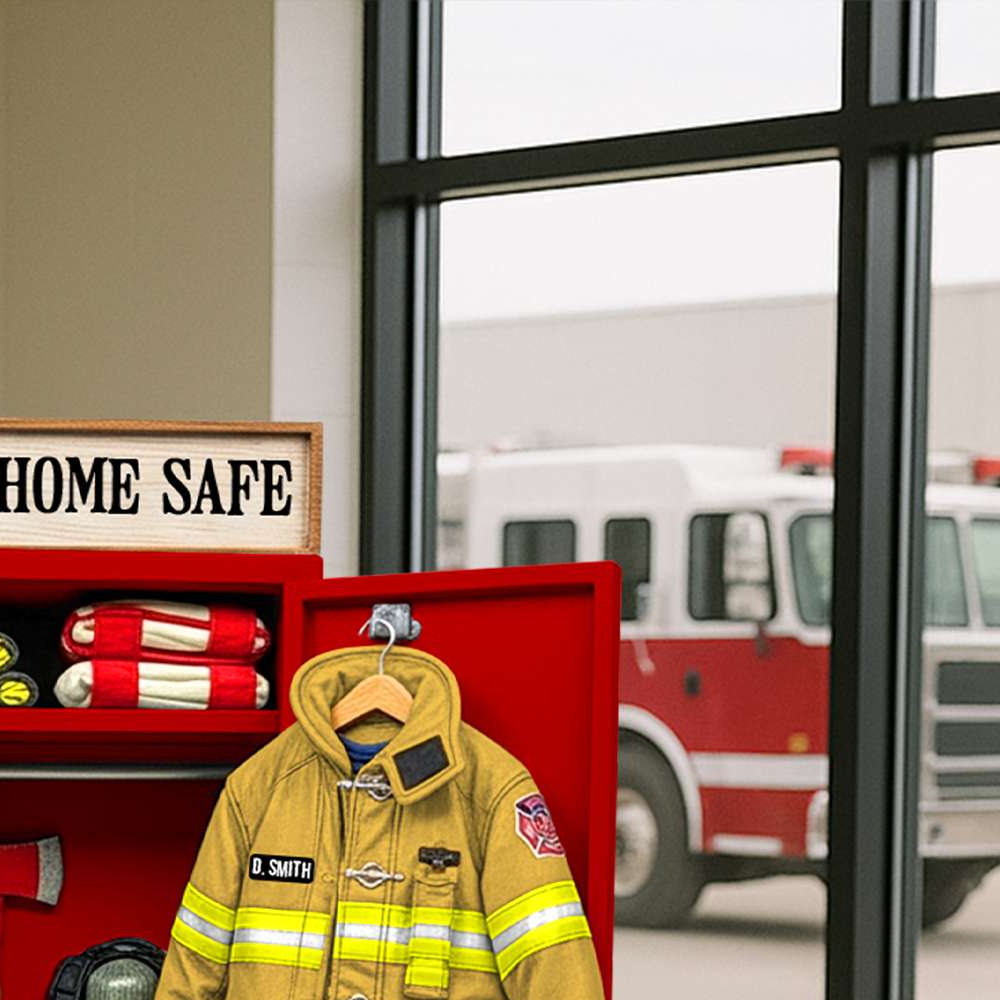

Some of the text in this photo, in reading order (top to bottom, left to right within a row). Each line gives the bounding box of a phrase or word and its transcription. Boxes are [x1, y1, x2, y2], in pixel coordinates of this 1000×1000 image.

[162, 458, 293, 517] SAFE
[252, 857, 312, 880] D. SMITH
